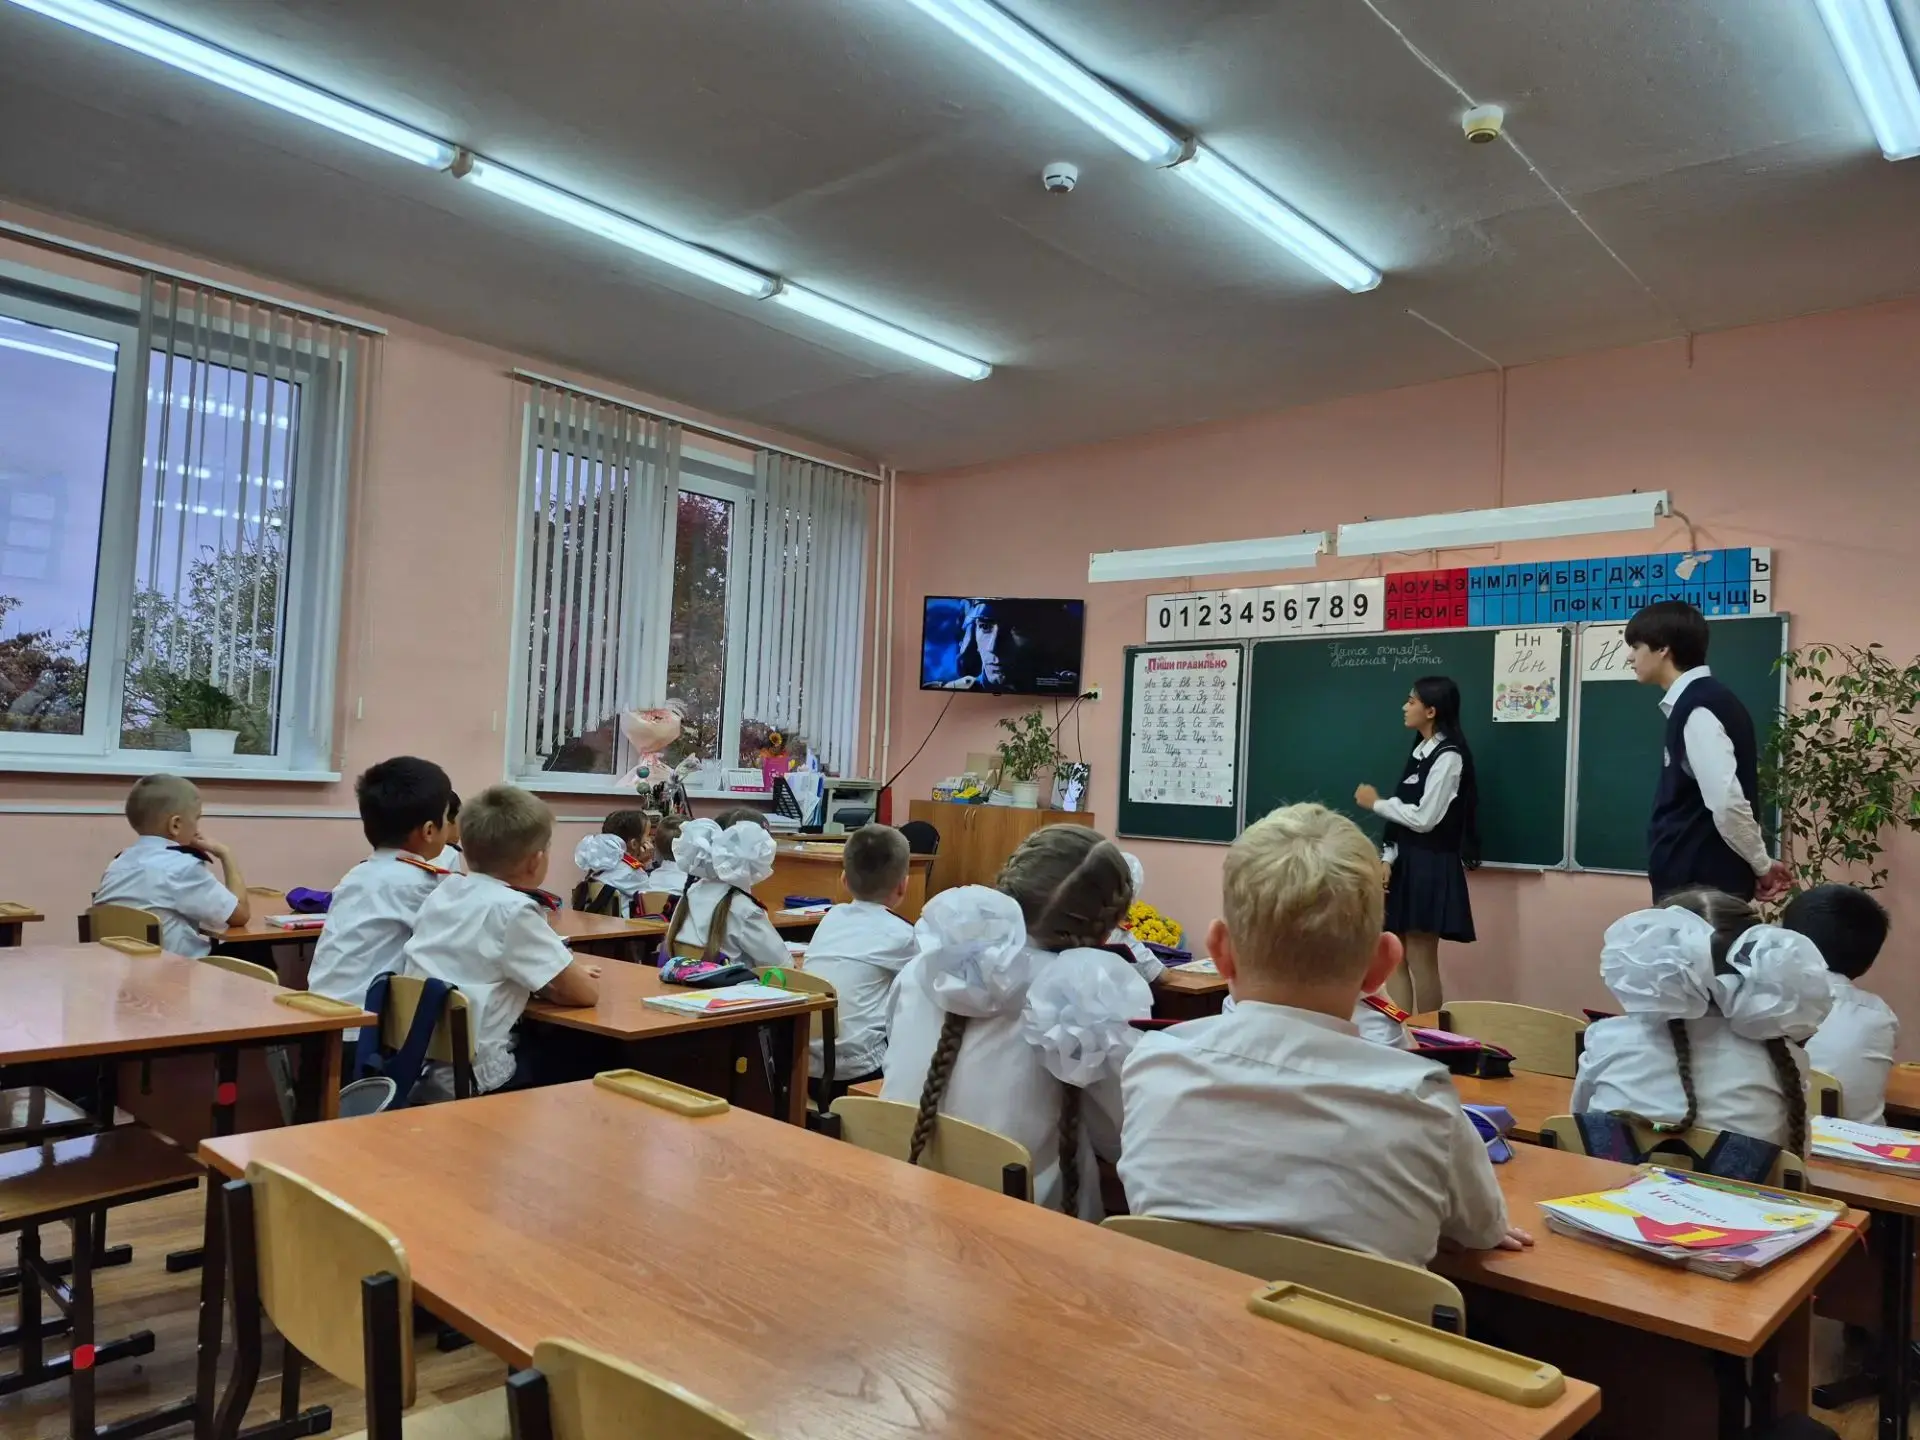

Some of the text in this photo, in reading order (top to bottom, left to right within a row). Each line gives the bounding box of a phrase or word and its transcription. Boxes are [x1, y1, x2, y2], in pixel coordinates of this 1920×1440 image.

[1388, 558, 1769, 595] А О У Ы Э Н М Л Р Й Б В Г Д Ж З Ъ
[1160, 593, 1368, 628] 0 1 2 3 4 5 6 7 8 9
[1387, 608, 1397, 620] Я
[1418, 606, 1432, 618] Ю
[1437, 606, 1447, 617] И
[1455, 605, 1464, 617] Е
[1554, 599, 1565, 612] П
[1571, 599, 1585, 611] Ф
[1592, 597, 1603, 611] К
[1610, 596, 1621, 609] Т
[1628, 595, 1645, 608] Ш
[1688, 592, 1701, 608] Ц
[1708, 592, 1720, 605] Ч
[1728, 590, 1747, 606] Щ
[1753, 589, 1767, 603] Ь
[1176, 660, 1227, 669] ПРАВИЛЬНО
